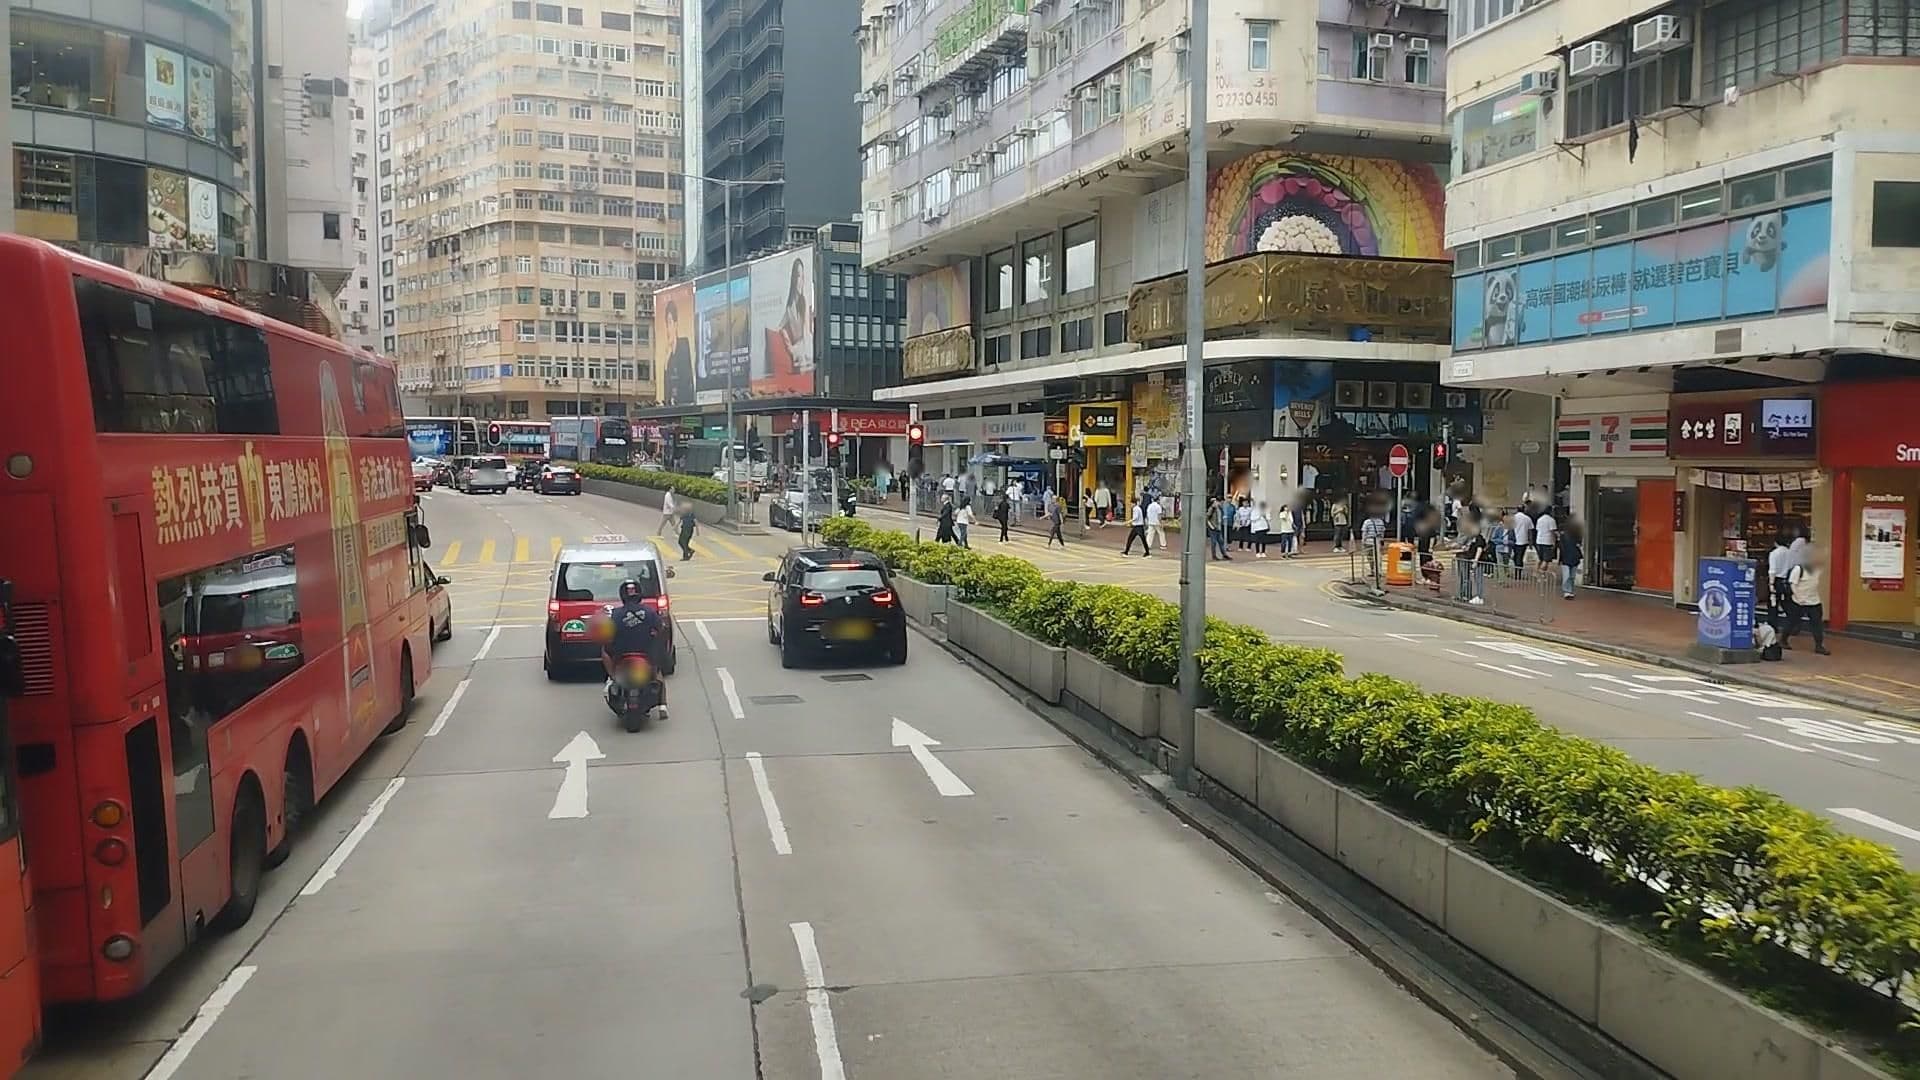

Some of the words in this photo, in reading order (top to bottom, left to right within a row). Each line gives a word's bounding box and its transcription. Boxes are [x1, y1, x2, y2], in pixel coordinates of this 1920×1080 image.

[1215, 391, 1235, 406] HILLS
[1681, 418, 1716, 440] 余仁生
[151, 463, 243, 545] 熱烈恭賀
[265, 457, 323, 521] 東鵬飲料
